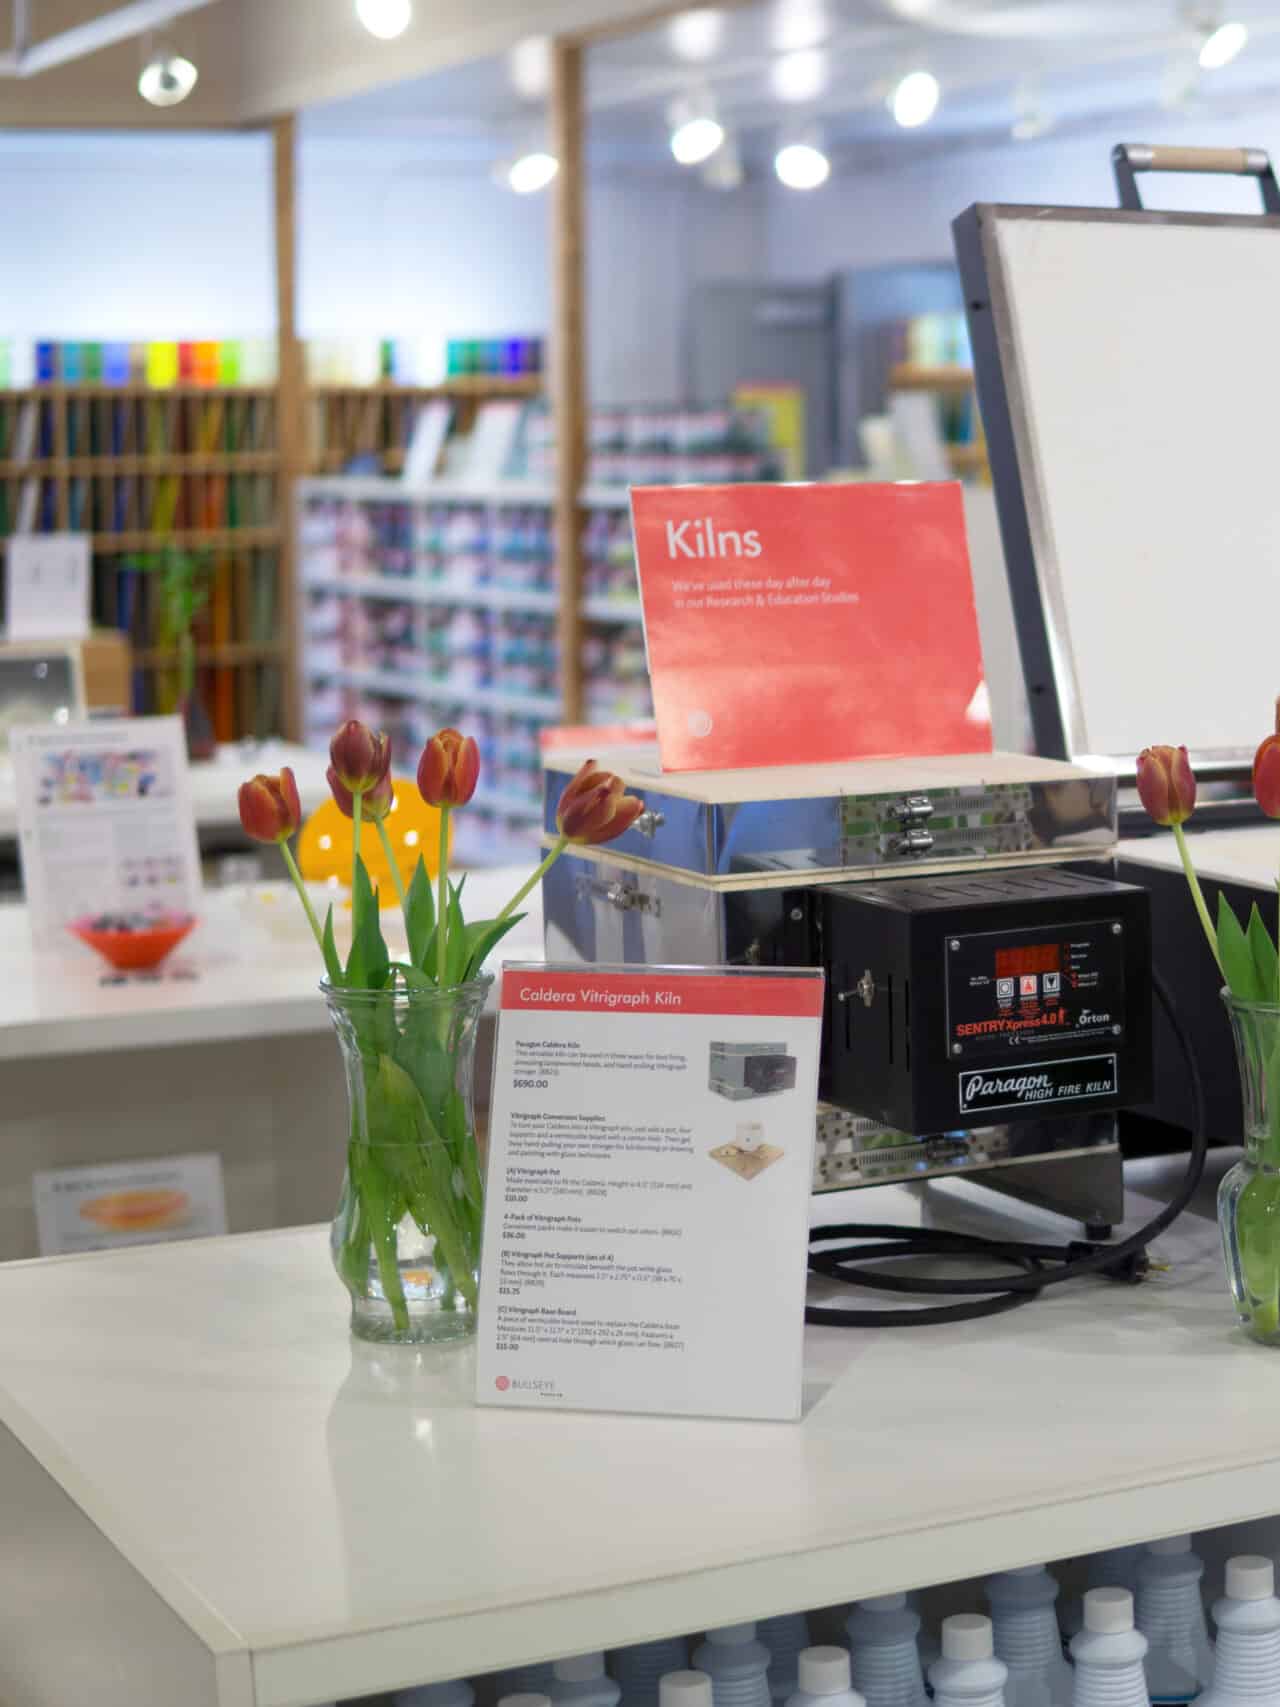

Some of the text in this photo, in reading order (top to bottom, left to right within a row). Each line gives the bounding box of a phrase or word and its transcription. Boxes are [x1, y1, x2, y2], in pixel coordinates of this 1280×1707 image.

[666, 518, 762, 559] Kilns
[766, 578, 784, 591] day
[812, 577, 830, 590] day
[706, 596, 754, 608] Research
[756, 594, 764, 607] &
[767, 593, 818, 606] Education
[519, 987, 681, 1007] Caldera Vitrigraph Kiln
[1079, 1013, 1109, 1024] Orton
[957, 1019, 1005, 1036] SENTRY
[513, 1079, 548, 1089] $690.00
[966, 1074, 1053, 1101] Paragon
[1025, 1080, 1111, 1101] HIGH FIRE KILN
